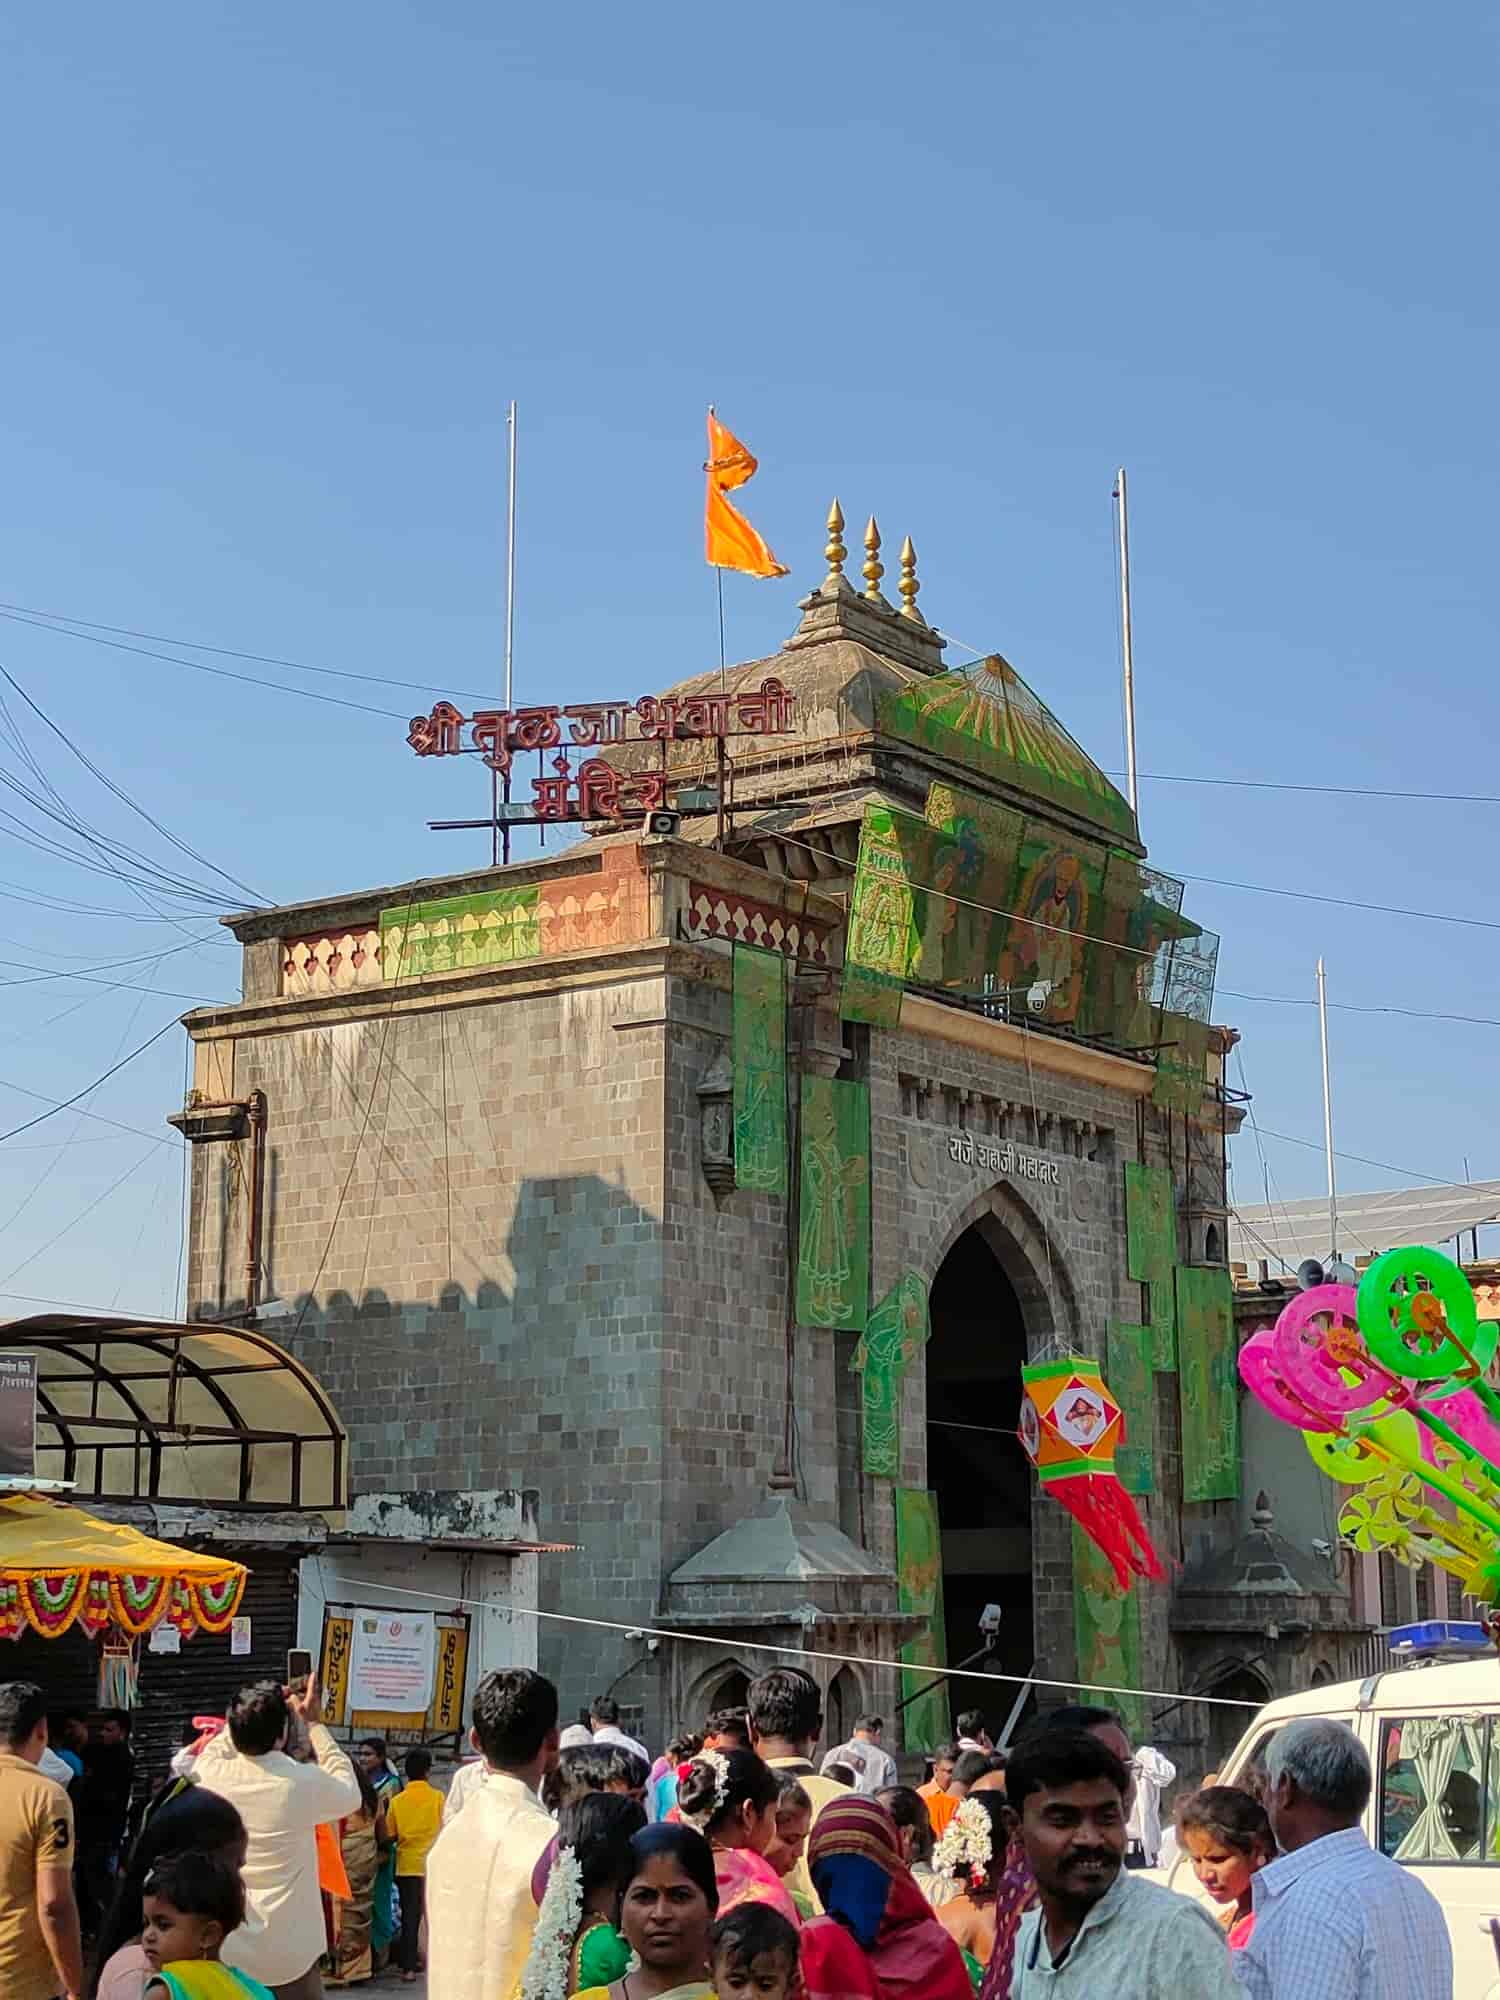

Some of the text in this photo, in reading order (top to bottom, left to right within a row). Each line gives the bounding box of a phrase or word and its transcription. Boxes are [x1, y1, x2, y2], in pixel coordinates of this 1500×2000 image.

[406, 700, 464, 755] श्री
[531, 753, 668, 822] मंदिर
[948, 1132, 975, 1166] राजे
[52, 1817, 69, 1850] 3
